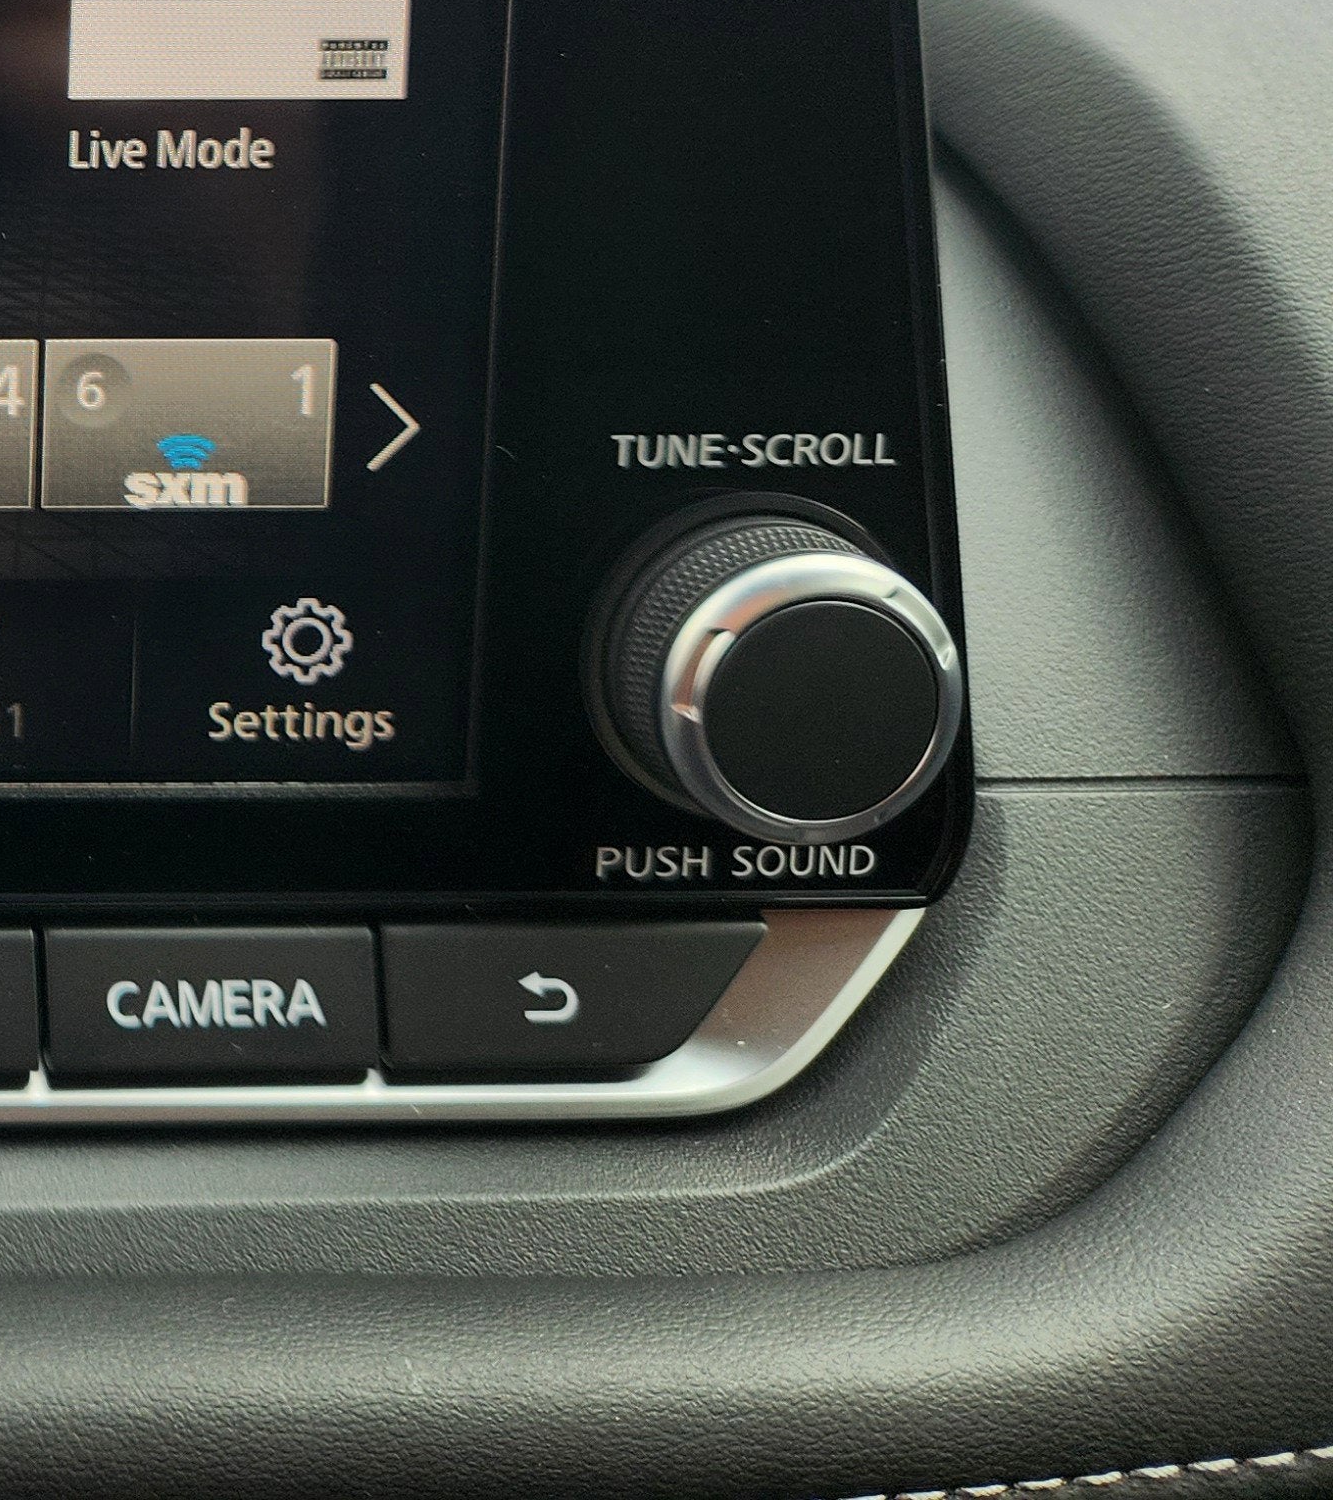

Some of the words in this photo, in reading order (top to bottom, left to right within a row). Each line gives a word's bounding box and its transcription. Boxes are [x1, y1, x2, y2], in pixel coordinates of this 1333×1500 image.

[68, 129, 146, 169] Live
[156, 127, 275, 169] Mode
[77, 370, 106, 408] 6
[293, 364, 315, 415] 1
[124, 470, 249, 506] sxm
[207, 701, 396, 751] Settings
[594, 846, 711, 880] PUSH
[731, 844, 876, 877] SOUND
[105, 980, 326, 1027] CAMERA
